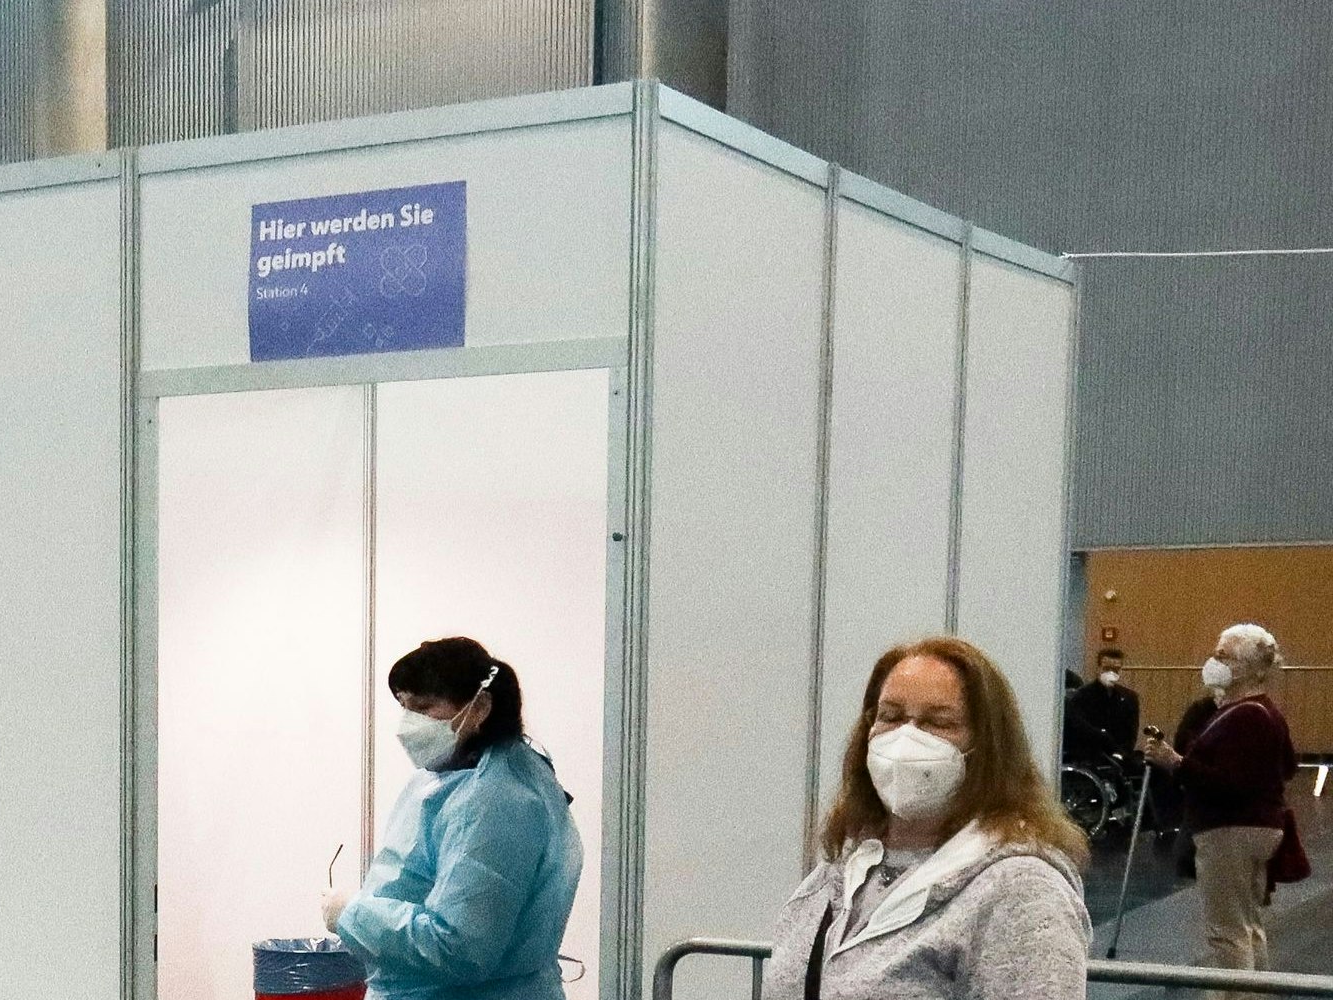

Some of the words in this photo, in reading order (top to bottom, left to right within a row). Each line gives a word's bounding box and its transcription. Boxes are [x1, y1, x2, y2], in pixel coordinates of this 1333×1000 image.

[259, 219, 307, 242] Hier
[310, 208, 395, 235] werden
[399, 202, 435, 227] Sie
[256, 242, 346, 278] geimpft
[256, 284, 298, 300] Station
